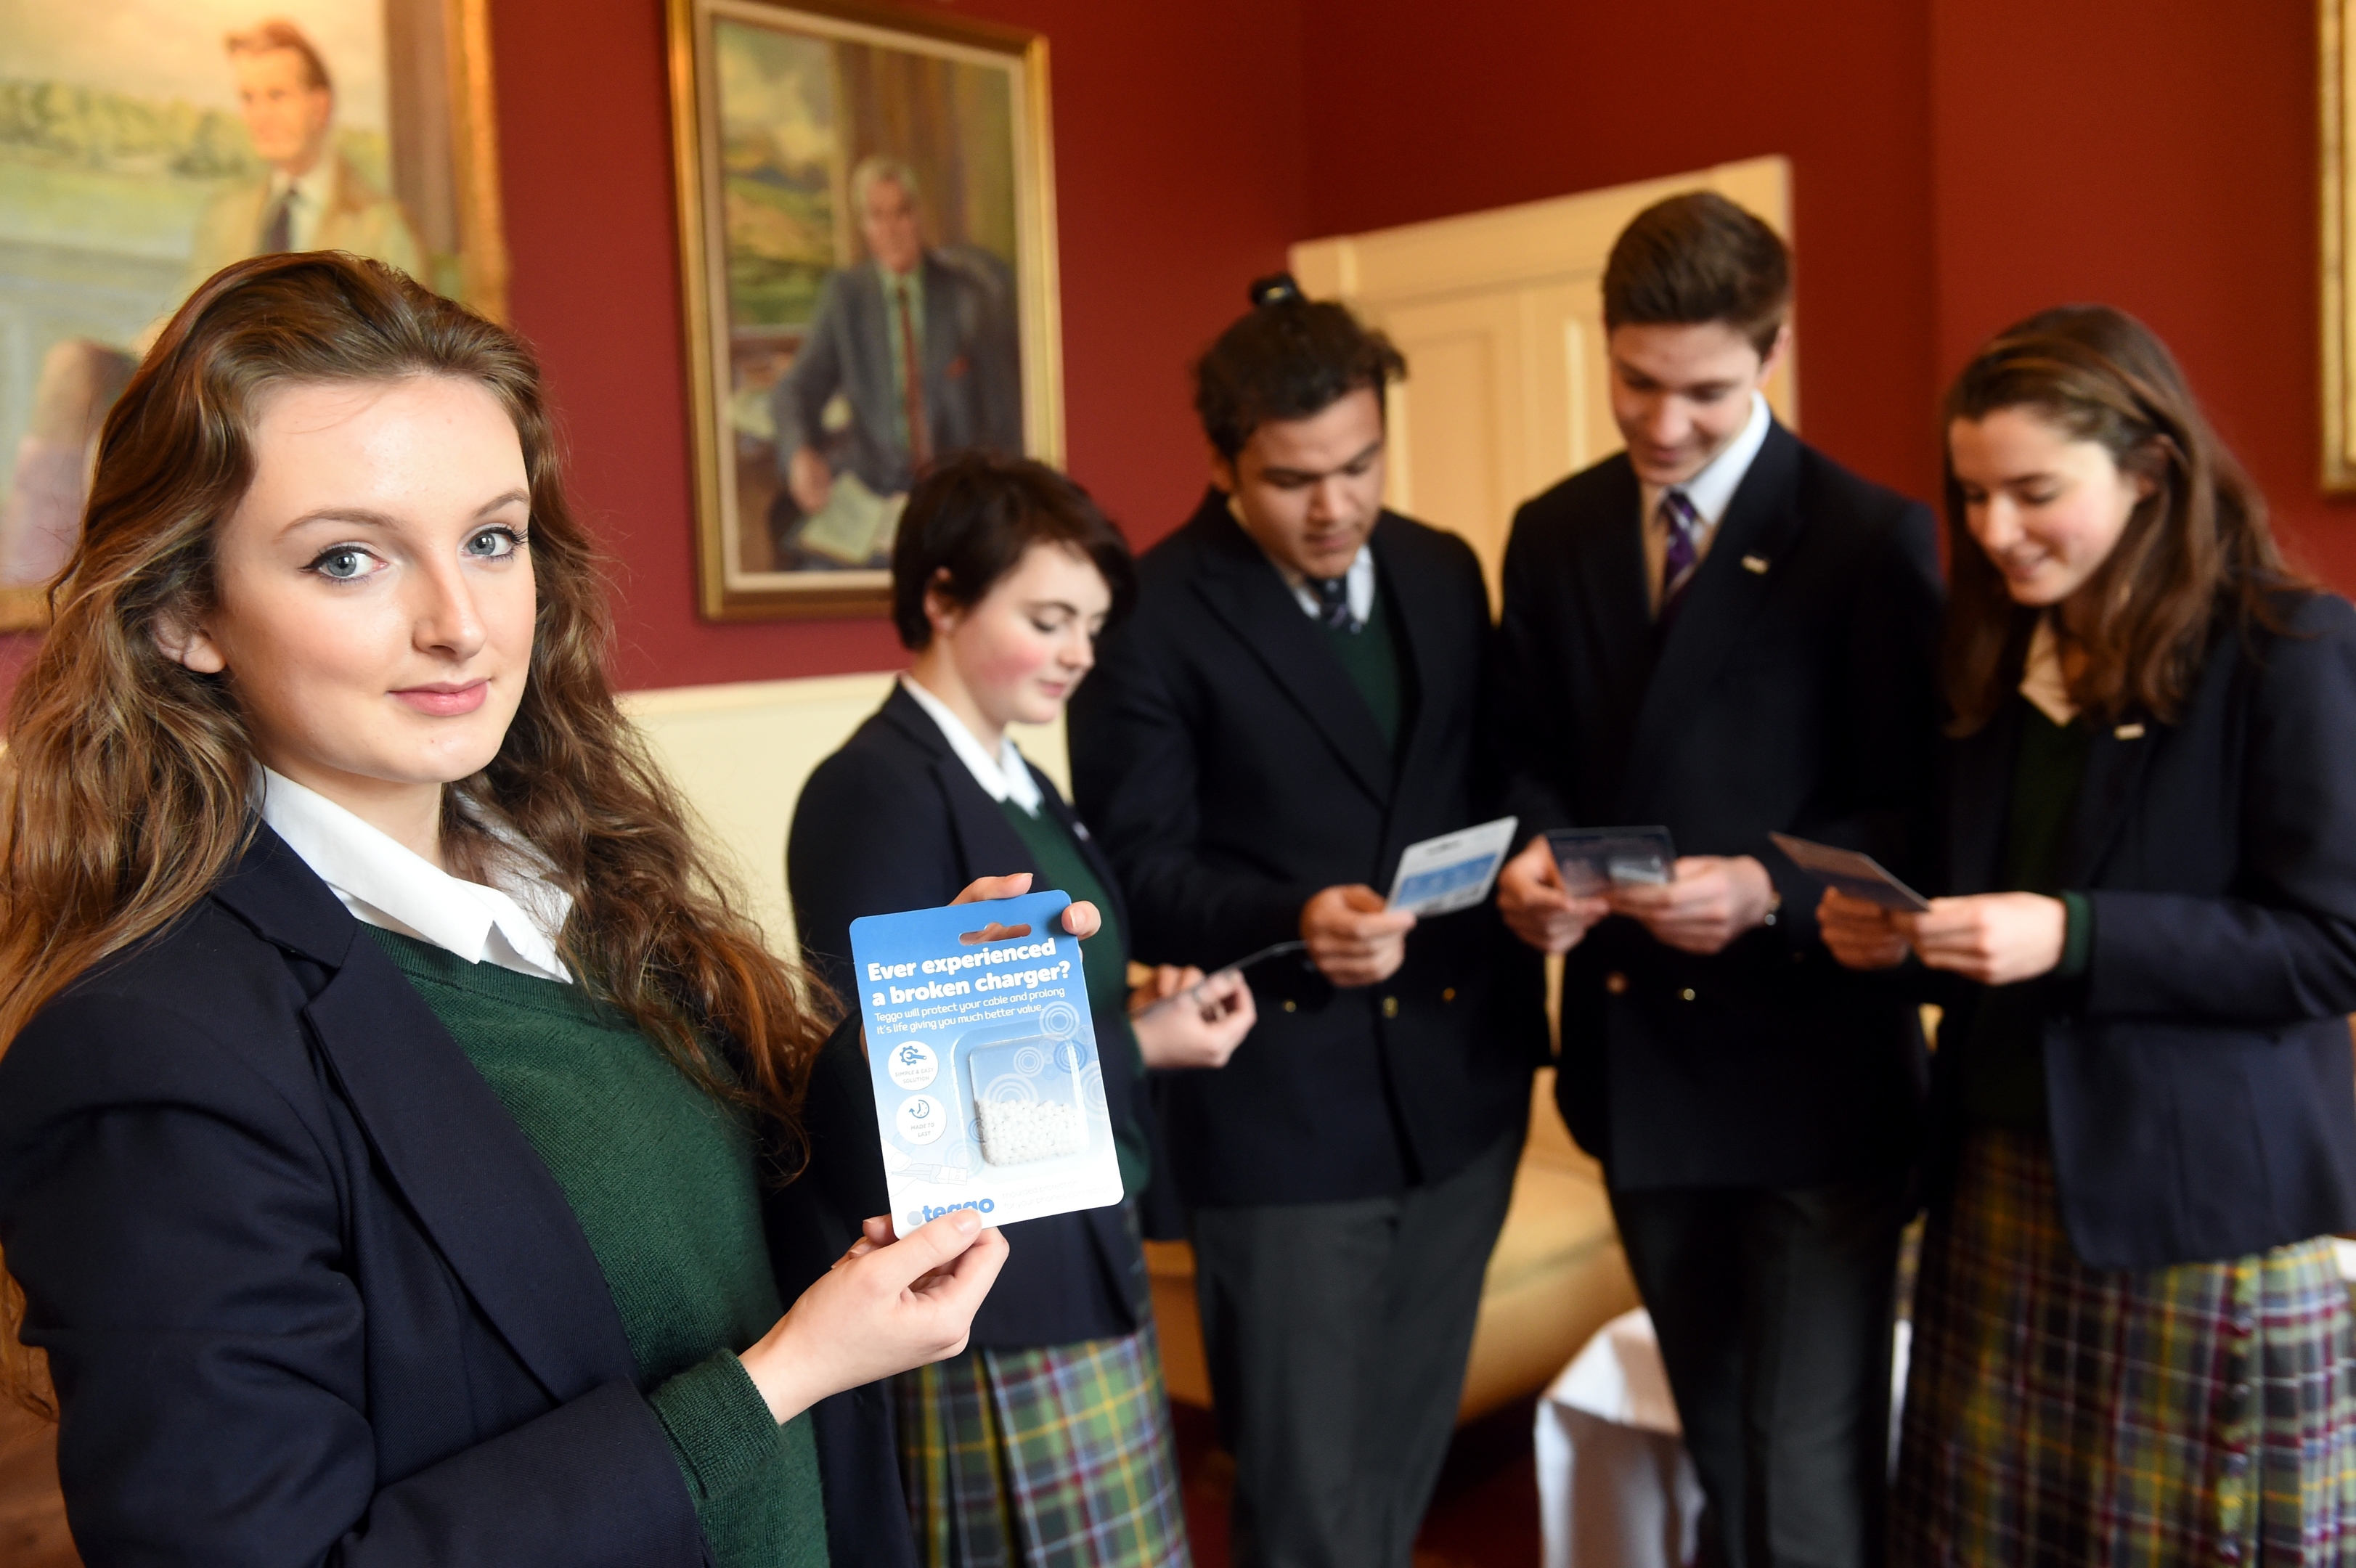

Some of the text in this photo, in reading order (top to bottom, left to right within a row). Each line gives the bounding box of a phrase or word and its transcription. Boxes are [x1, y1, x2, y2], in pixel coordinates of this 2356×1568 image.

[868, 937, 1056, 981] Ever experienced
[872, 960, 1070, 1006] a broken charger?
[874, 987, 1065, 1024] Teggo will protect your cable and prolong
[876, 1004, 1044, 1035] it's life giving you much better value.
